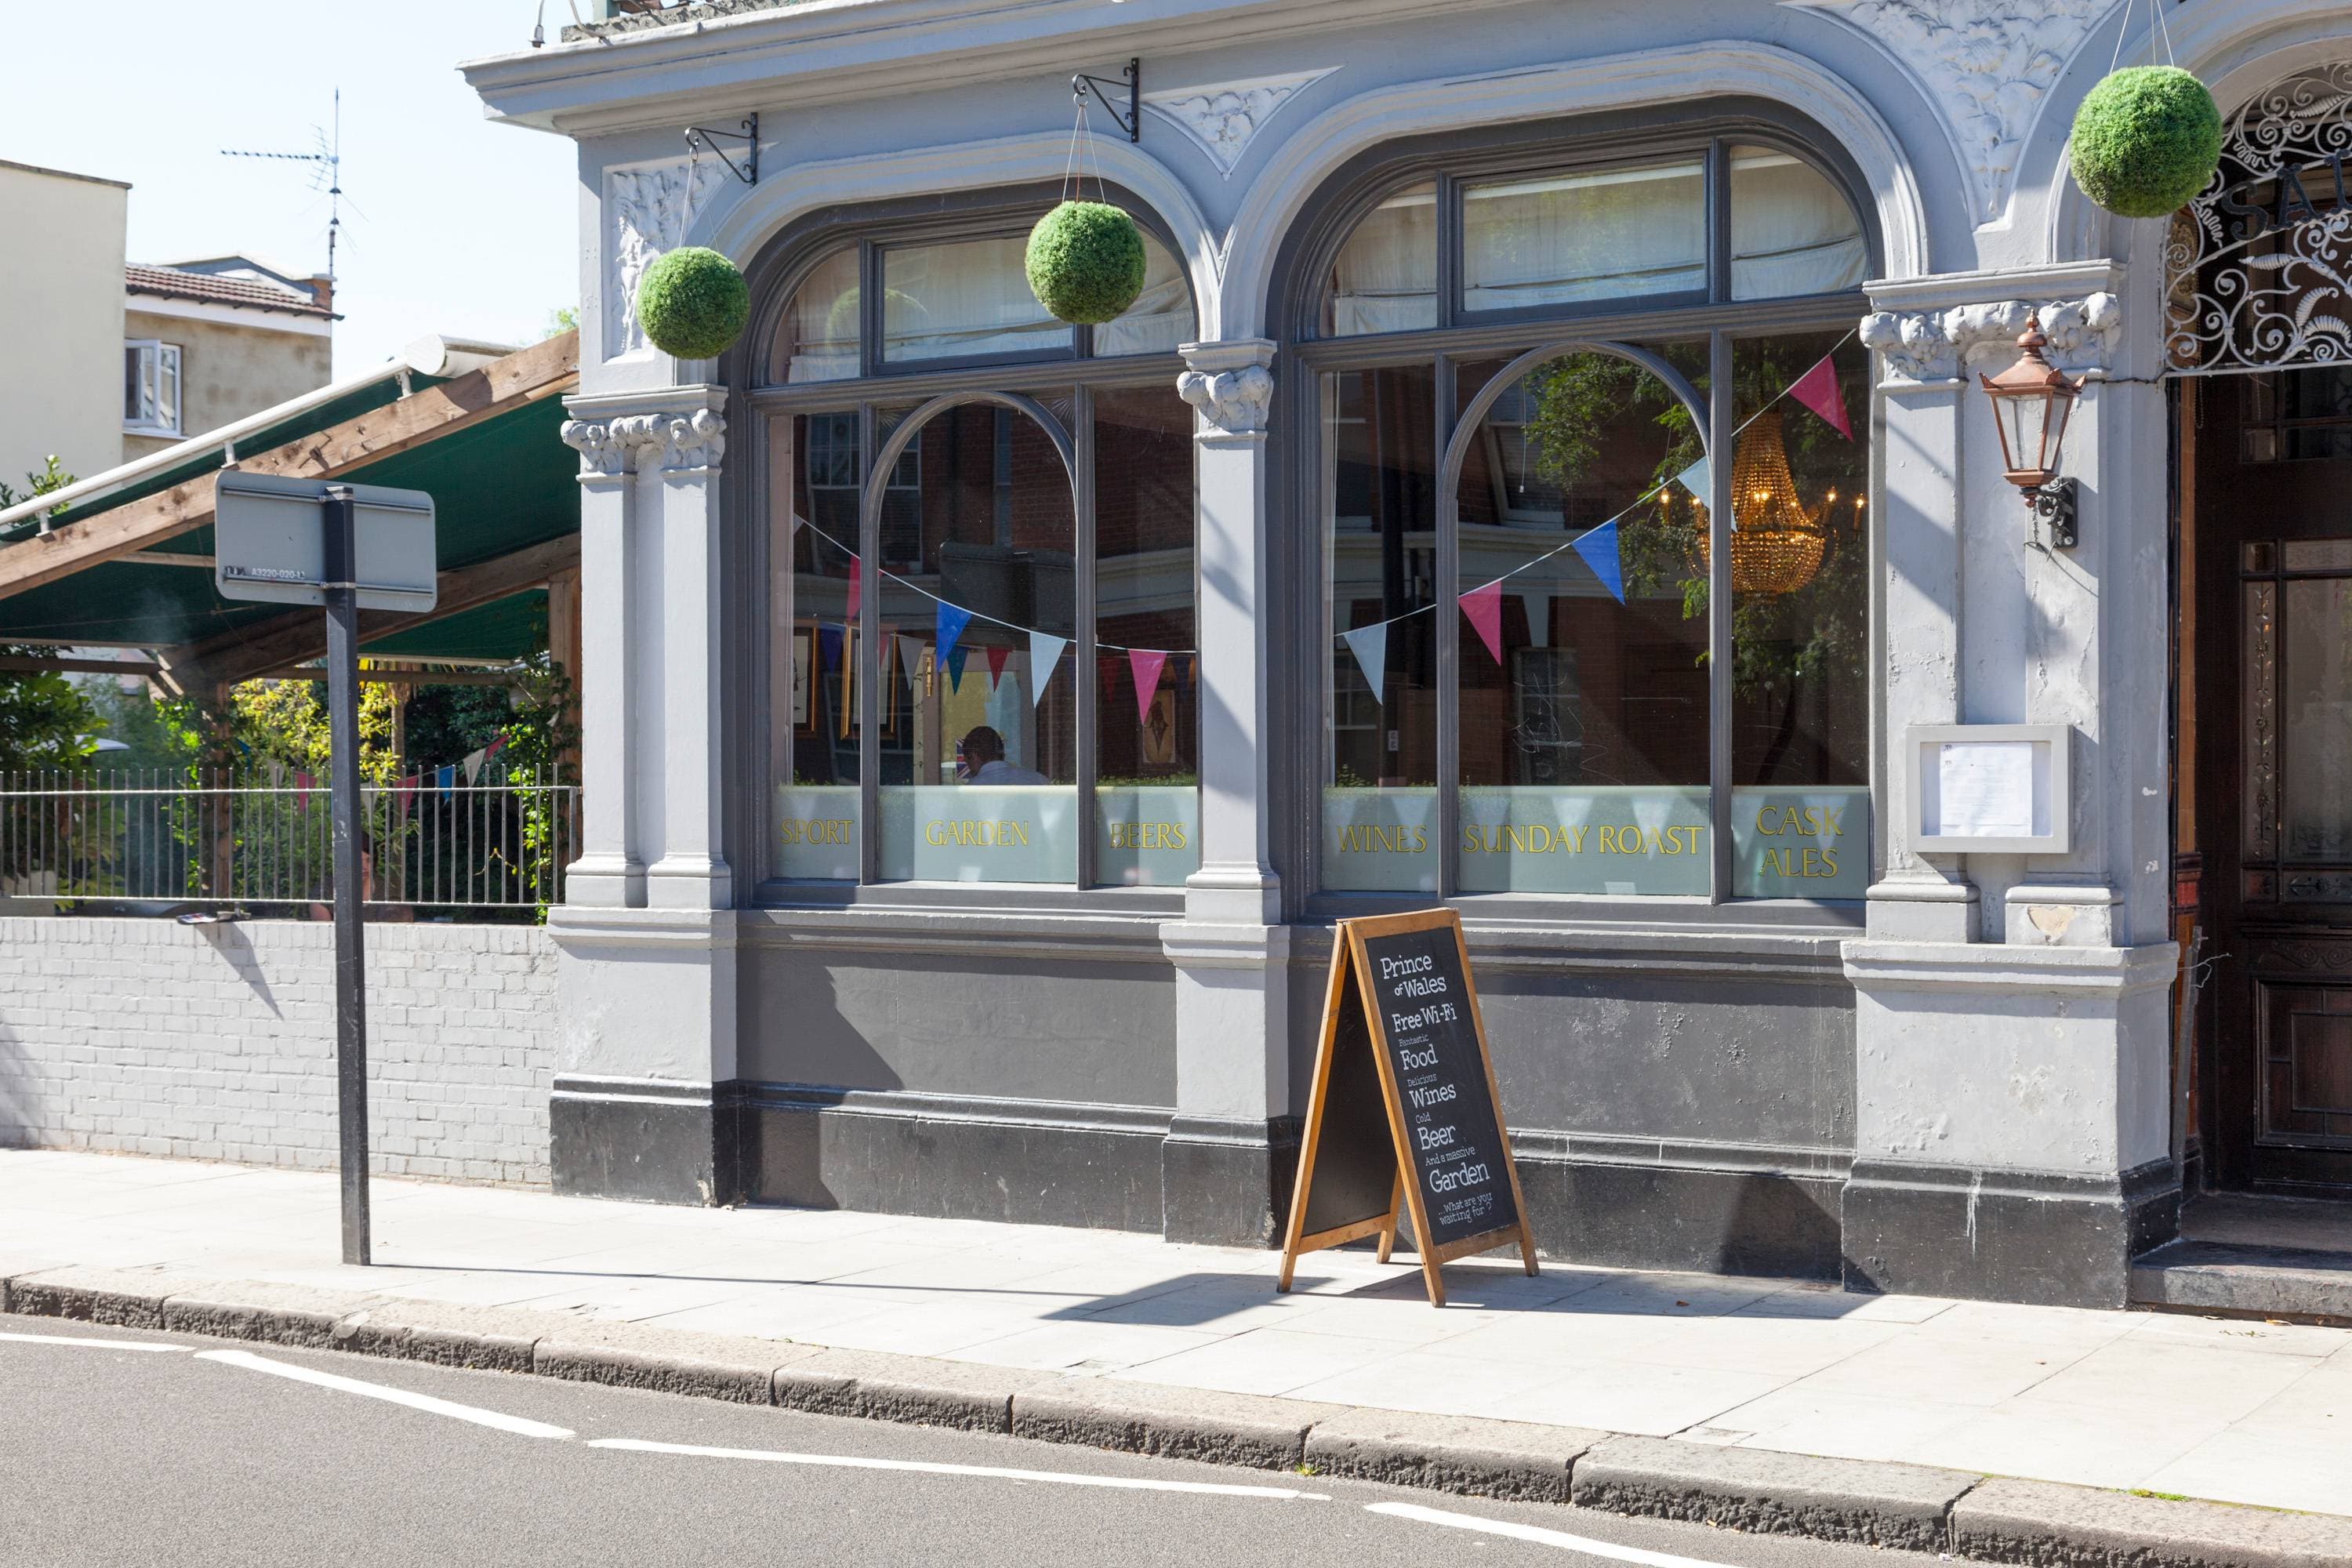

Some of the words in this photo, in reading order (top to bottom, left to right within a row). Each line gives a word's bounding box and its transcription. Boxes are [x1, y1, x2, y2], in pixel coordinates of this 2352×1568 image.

[779, 819, 854, 845] SPORT
[924, 819, 1029, 847] GARDEN
[1755, 805, 1844, 837] CASK
[1109, 822, 1187, 849] BEERS
[1337, 824, 1427, 854] WINES
[1463, 824, 1590, 855] SUNDAY
[1599, 825, 1705, 856] ROAST
[1758, 848, 1838, 879] ALES
[1381, 955, 1432, 979] Prince
[1394, 983, 1403, 996] of
[1403, 977, 1446, 998] Wales
[1392, 1013, 1423, 1033] Free
[1420, 1002, 1457, 1025] Wi-Fi
[1398, 1034, 1429, 1047] Fantastic
[1399, 1044, 1439, 1070] Food
[1407, 1073, 1437, 1087] Delicious
[1409, 1083, 1457, 1109] Wines
[1415, 1112, 1432, 1123] Cold
[1417, 1125, 1456, 1150] Beer
[1425, 1153, 1441, 1166] And
[1440, 1154, 1446, 1163] a
[1446, 1146, 1475, 1161] massive
[1429, 1162, 1490, 1192] Garden
[1465, 1197, 1476, 1207] are
[1476, 1192, 1493, 1207] you
[1439, 1209, 1472, 1225] waiting
[1472, 1206, 1486, 1217] for
